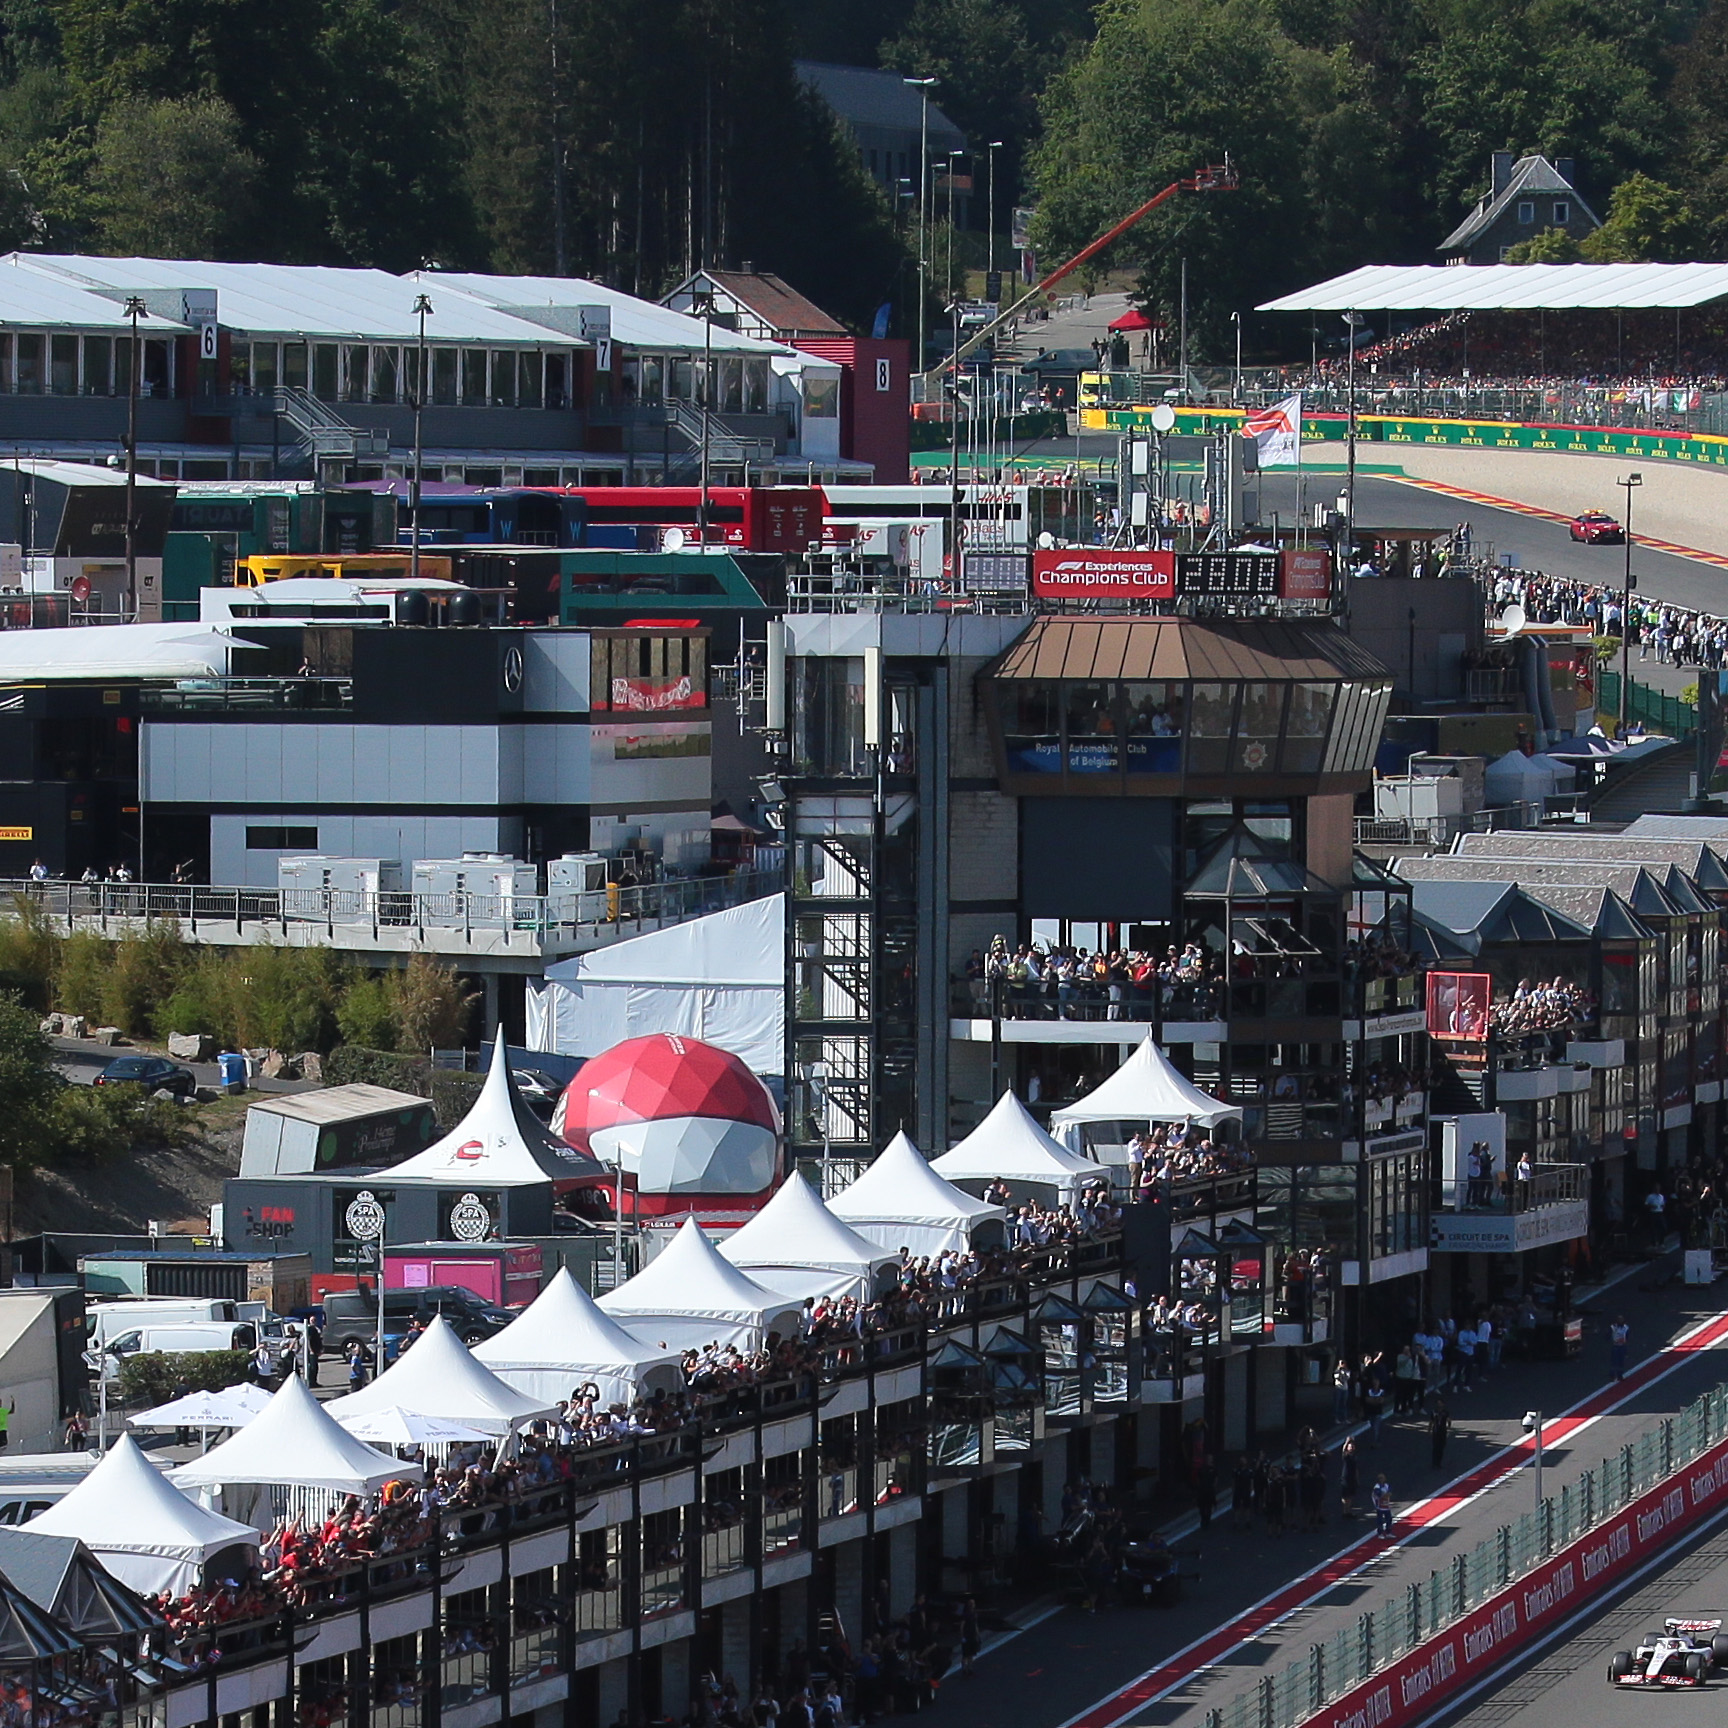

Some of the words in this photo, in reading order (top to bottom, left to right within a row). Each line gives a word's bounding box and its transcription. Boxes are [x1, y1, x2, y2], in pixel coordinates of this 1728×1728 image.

[203, 326, 215, 358] 6
[600, 341, 609, 369] 7
[877, 361, 887, 389] 8
[1389, 433, 1412, 441] ROLEX
[1424, 435, 1448, 444] ROLEX
[1460, 437, 1483, 446] ROLEX
[1496, 439, 1520, 447] ROLEX
[1533, 440, 1556, 449] ROLEX
[1568, 442, 1587, 451] ROLEX
[1085, 562, 1153, 571] Experiences
[1039, 571, 1129, 586] Champions
[1132, 571, 1168, 585] Club
[1184, 558, 1276, 591] 28.08
[1035, 743, 1060, 756] Royal
[1069, 743, 1119, 754] Automobile
[1127, 744, 1147, 754] Club
[1070, 755, 1079, 766] of
[1082, 756, 1118, 768] Belgium
[261, 1207, 294, 1222] FAN
[356, 1206, 374, 1216] SPA
[461, 1208, 479, 1219] SPA
[252, 1222, 294, 1238] SHOP
[1448, 1233, 1480, 1241] CIRCUIT
[1481, 1233, 1492, 1241] DE
[1493, 1233, 1510, 1241] SPA
